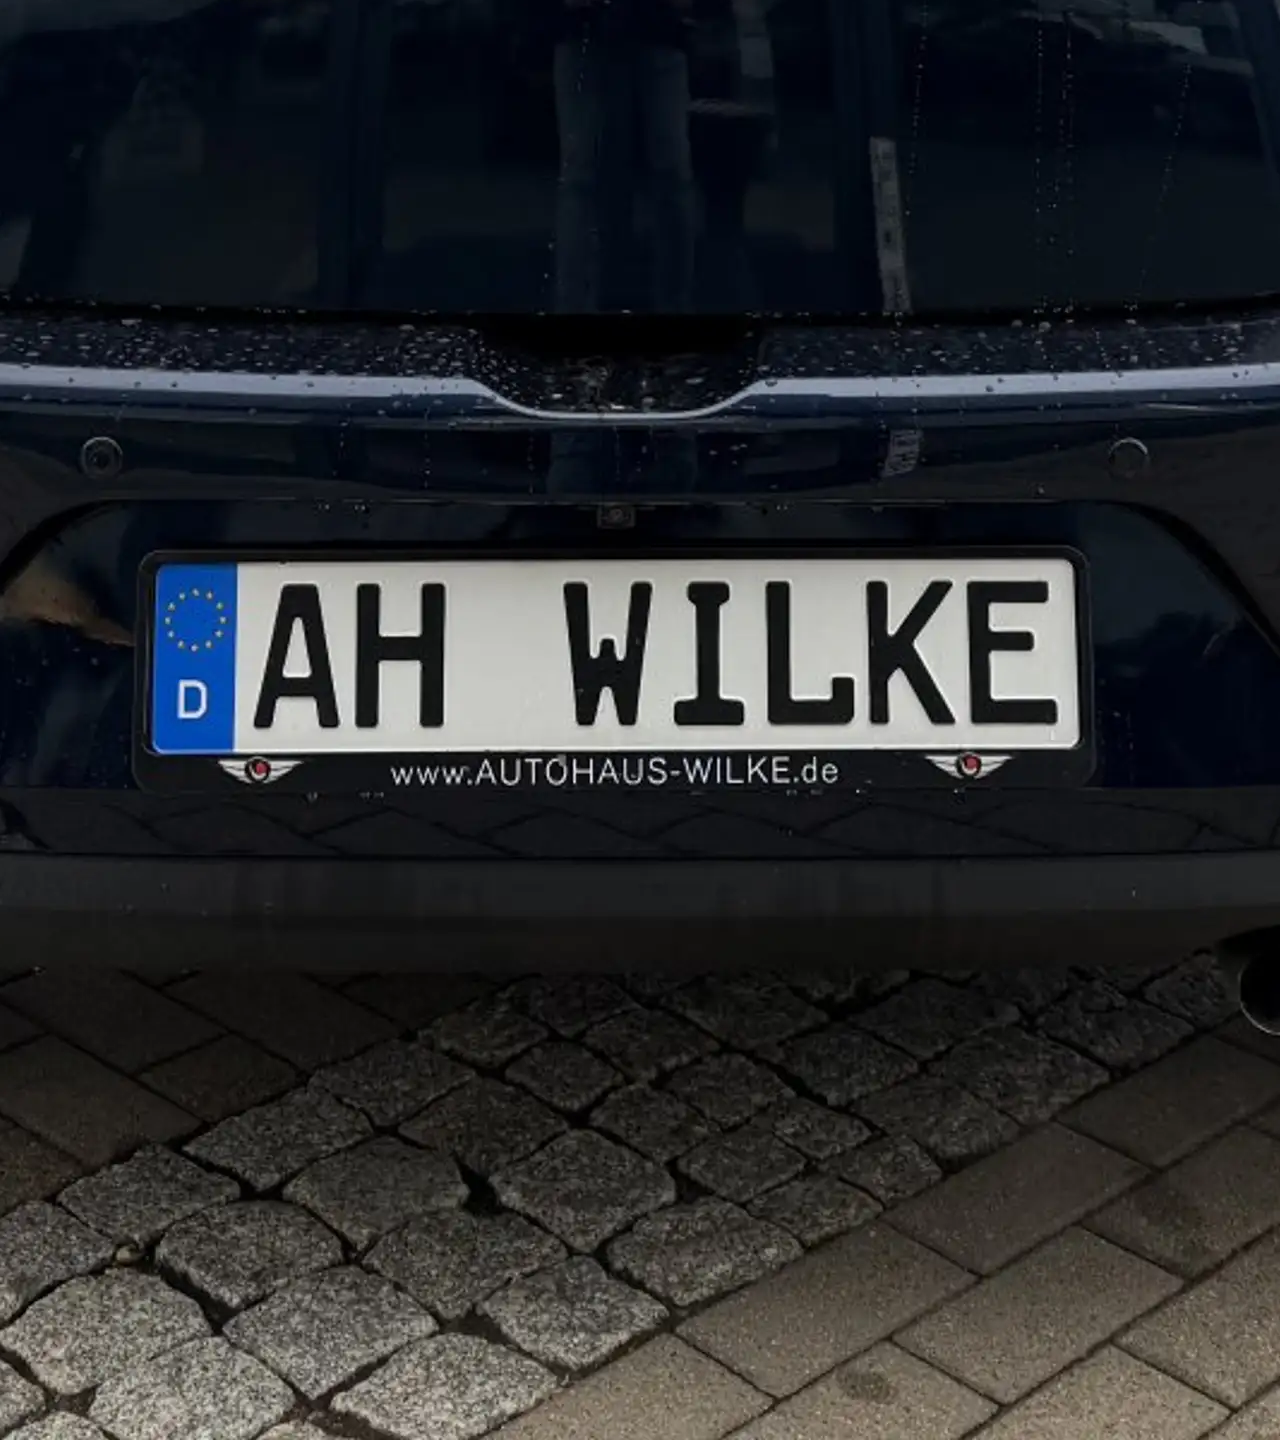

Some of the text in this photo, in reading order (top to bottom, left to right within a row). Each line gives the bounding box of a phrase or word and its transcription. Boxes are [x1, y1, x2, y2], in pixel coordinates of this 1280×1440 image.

[177, 580, 1058, 729] D AH WILKE
[389, 757, 839, 787] www.AUTOHAUS-WILKE.de
